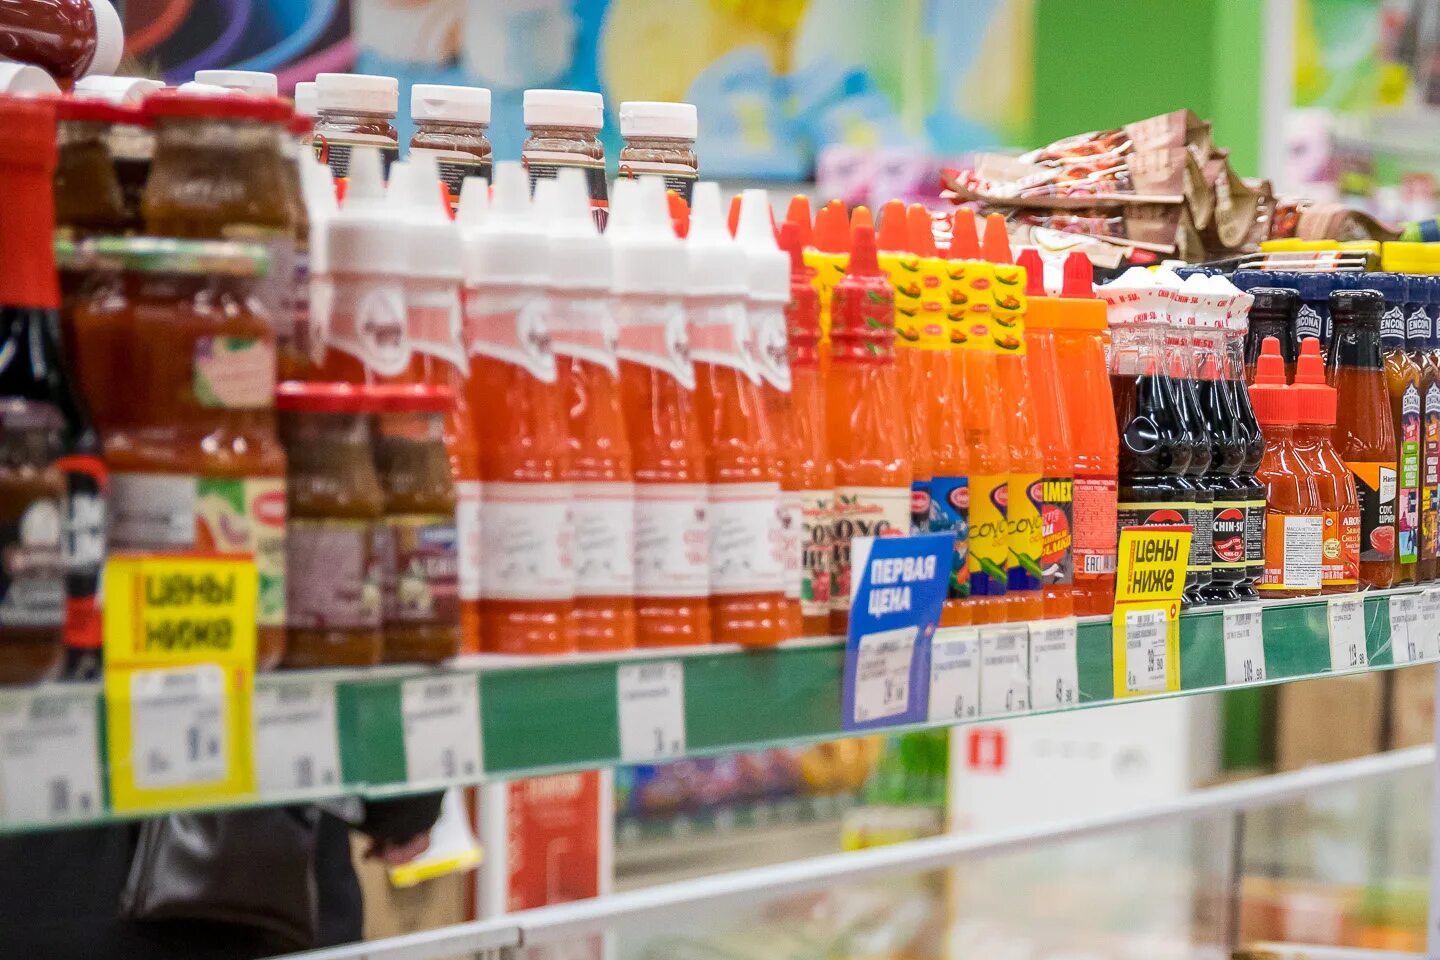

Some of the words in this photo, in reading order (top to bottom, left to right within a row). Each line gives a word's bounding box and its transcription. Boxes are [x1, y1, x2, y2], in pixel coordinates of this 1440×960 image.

[1213, 521, 1244, 532] CHIN-SU
[1136, 539, 1179, 563] цены
[871, 555, 937, 585] ПЕРВАЯ
[1133, 569, 1175, 593] ниже
[868, 587, 911, 619] ЦЕНА
